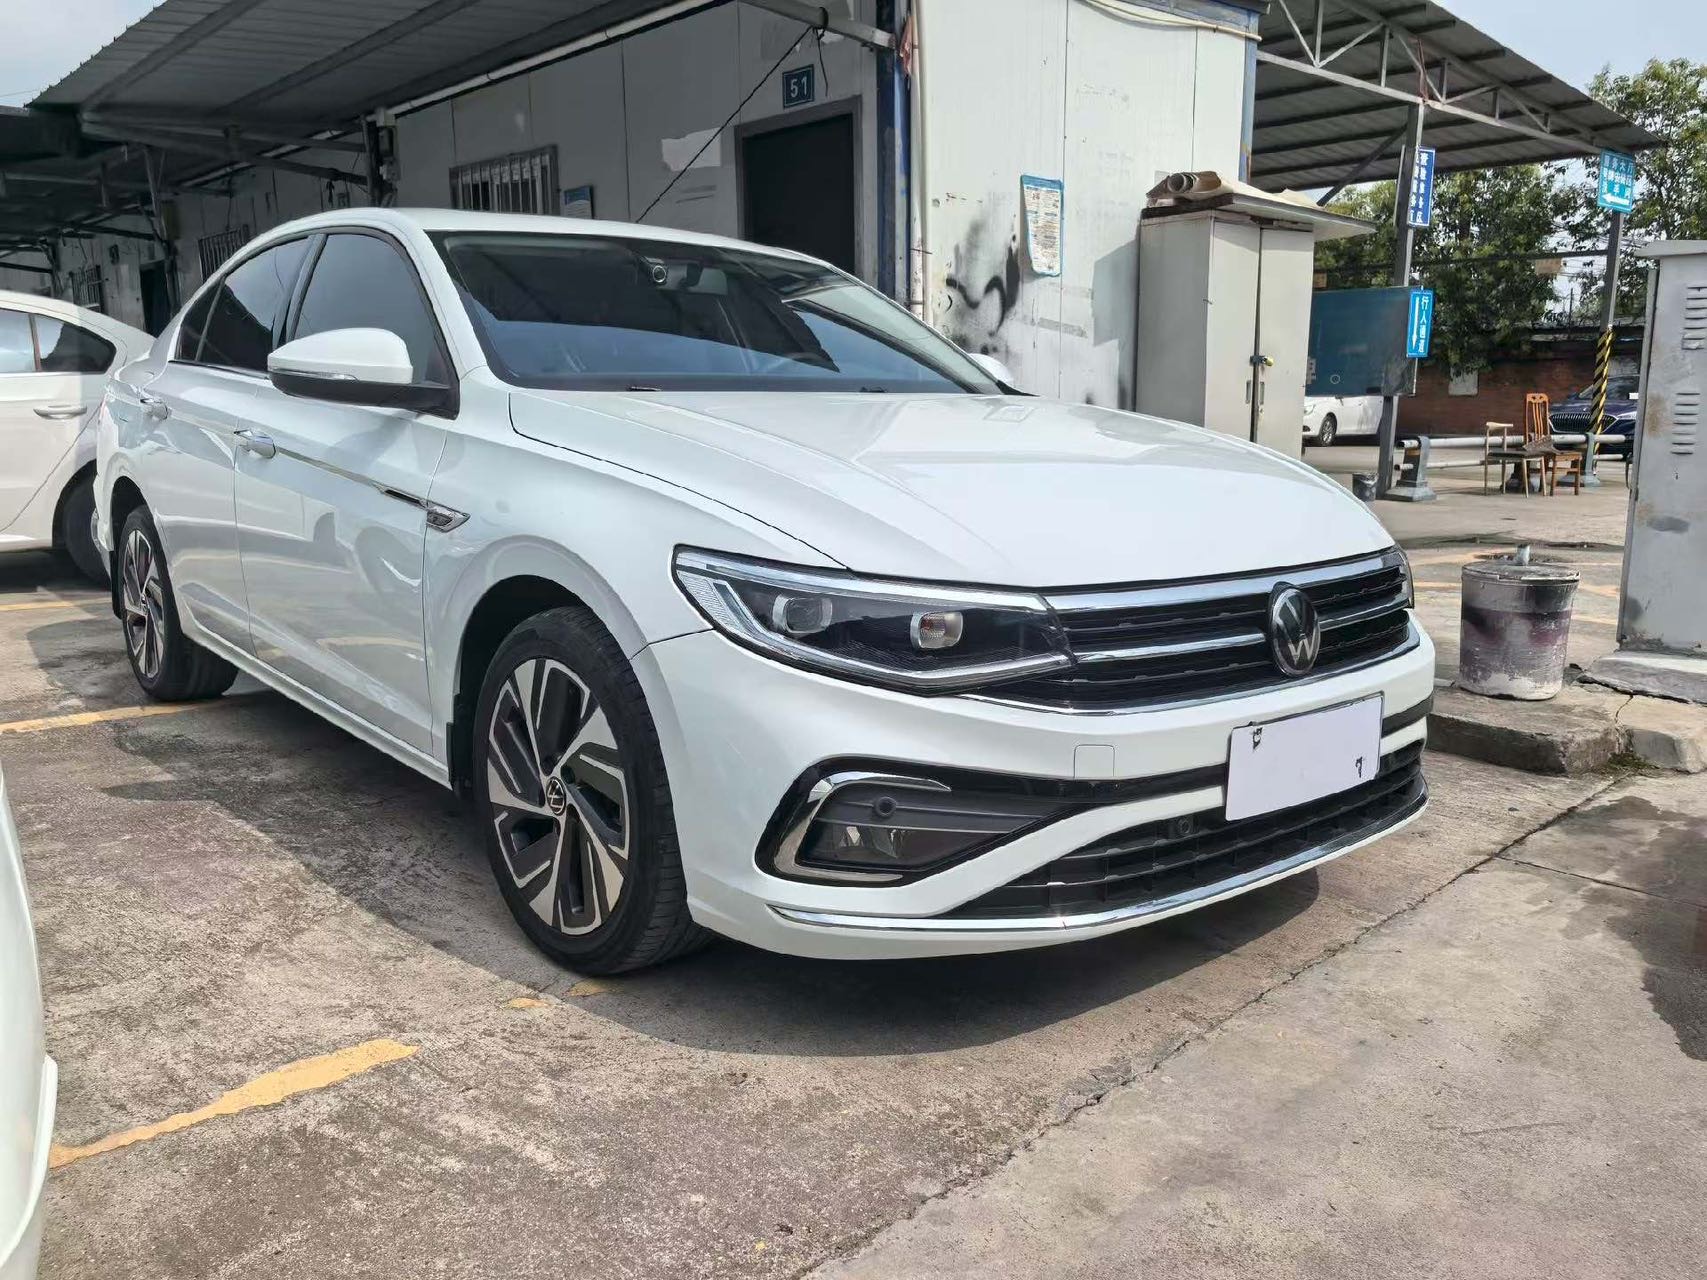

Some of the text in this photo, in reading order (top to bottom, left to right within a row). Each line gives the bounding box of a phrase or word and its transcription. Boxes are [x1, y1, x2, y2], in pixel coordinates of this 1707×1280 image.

[790, 76, 807, 98] 51
[1418, 295, 1430, 353] 行人通道
